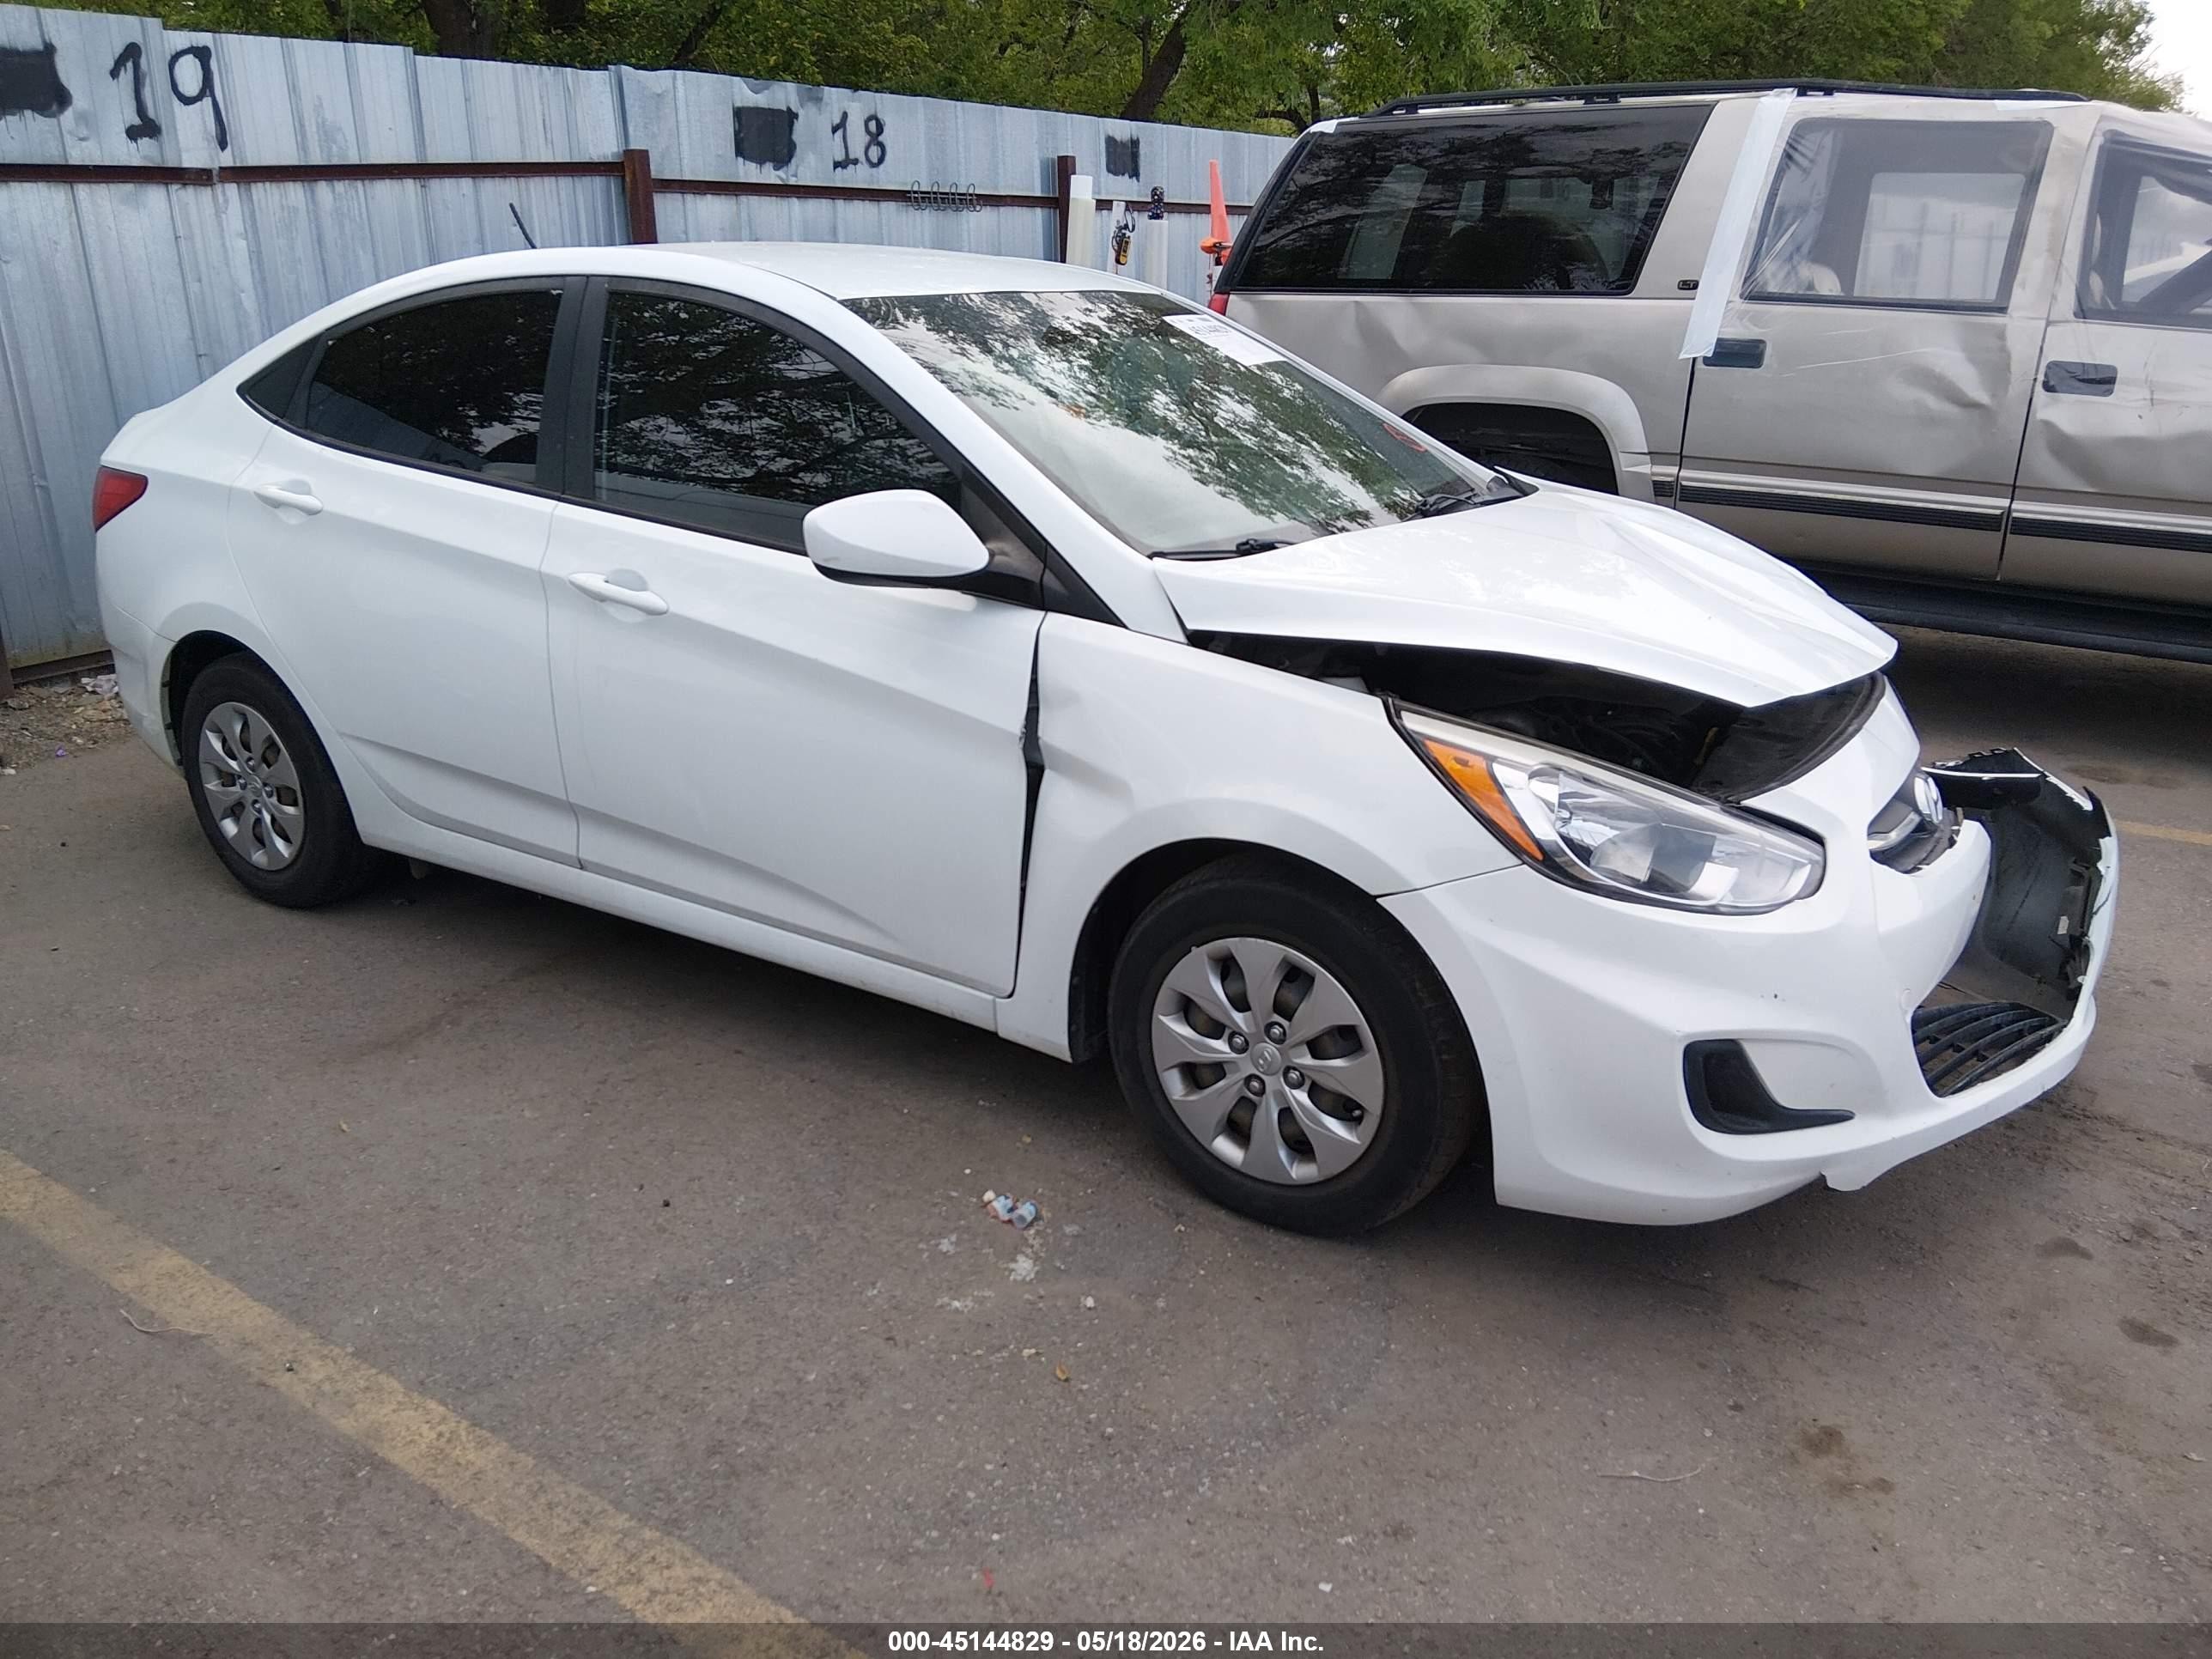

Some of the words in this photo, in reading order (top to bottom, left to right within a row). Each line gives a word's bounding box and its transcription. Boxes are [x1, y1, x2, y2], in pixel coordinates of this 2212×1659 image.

[109, 41, 228, 152] 19
[831, 111, 887, 173] 18
[1679, 280, 1697, 289] LT
